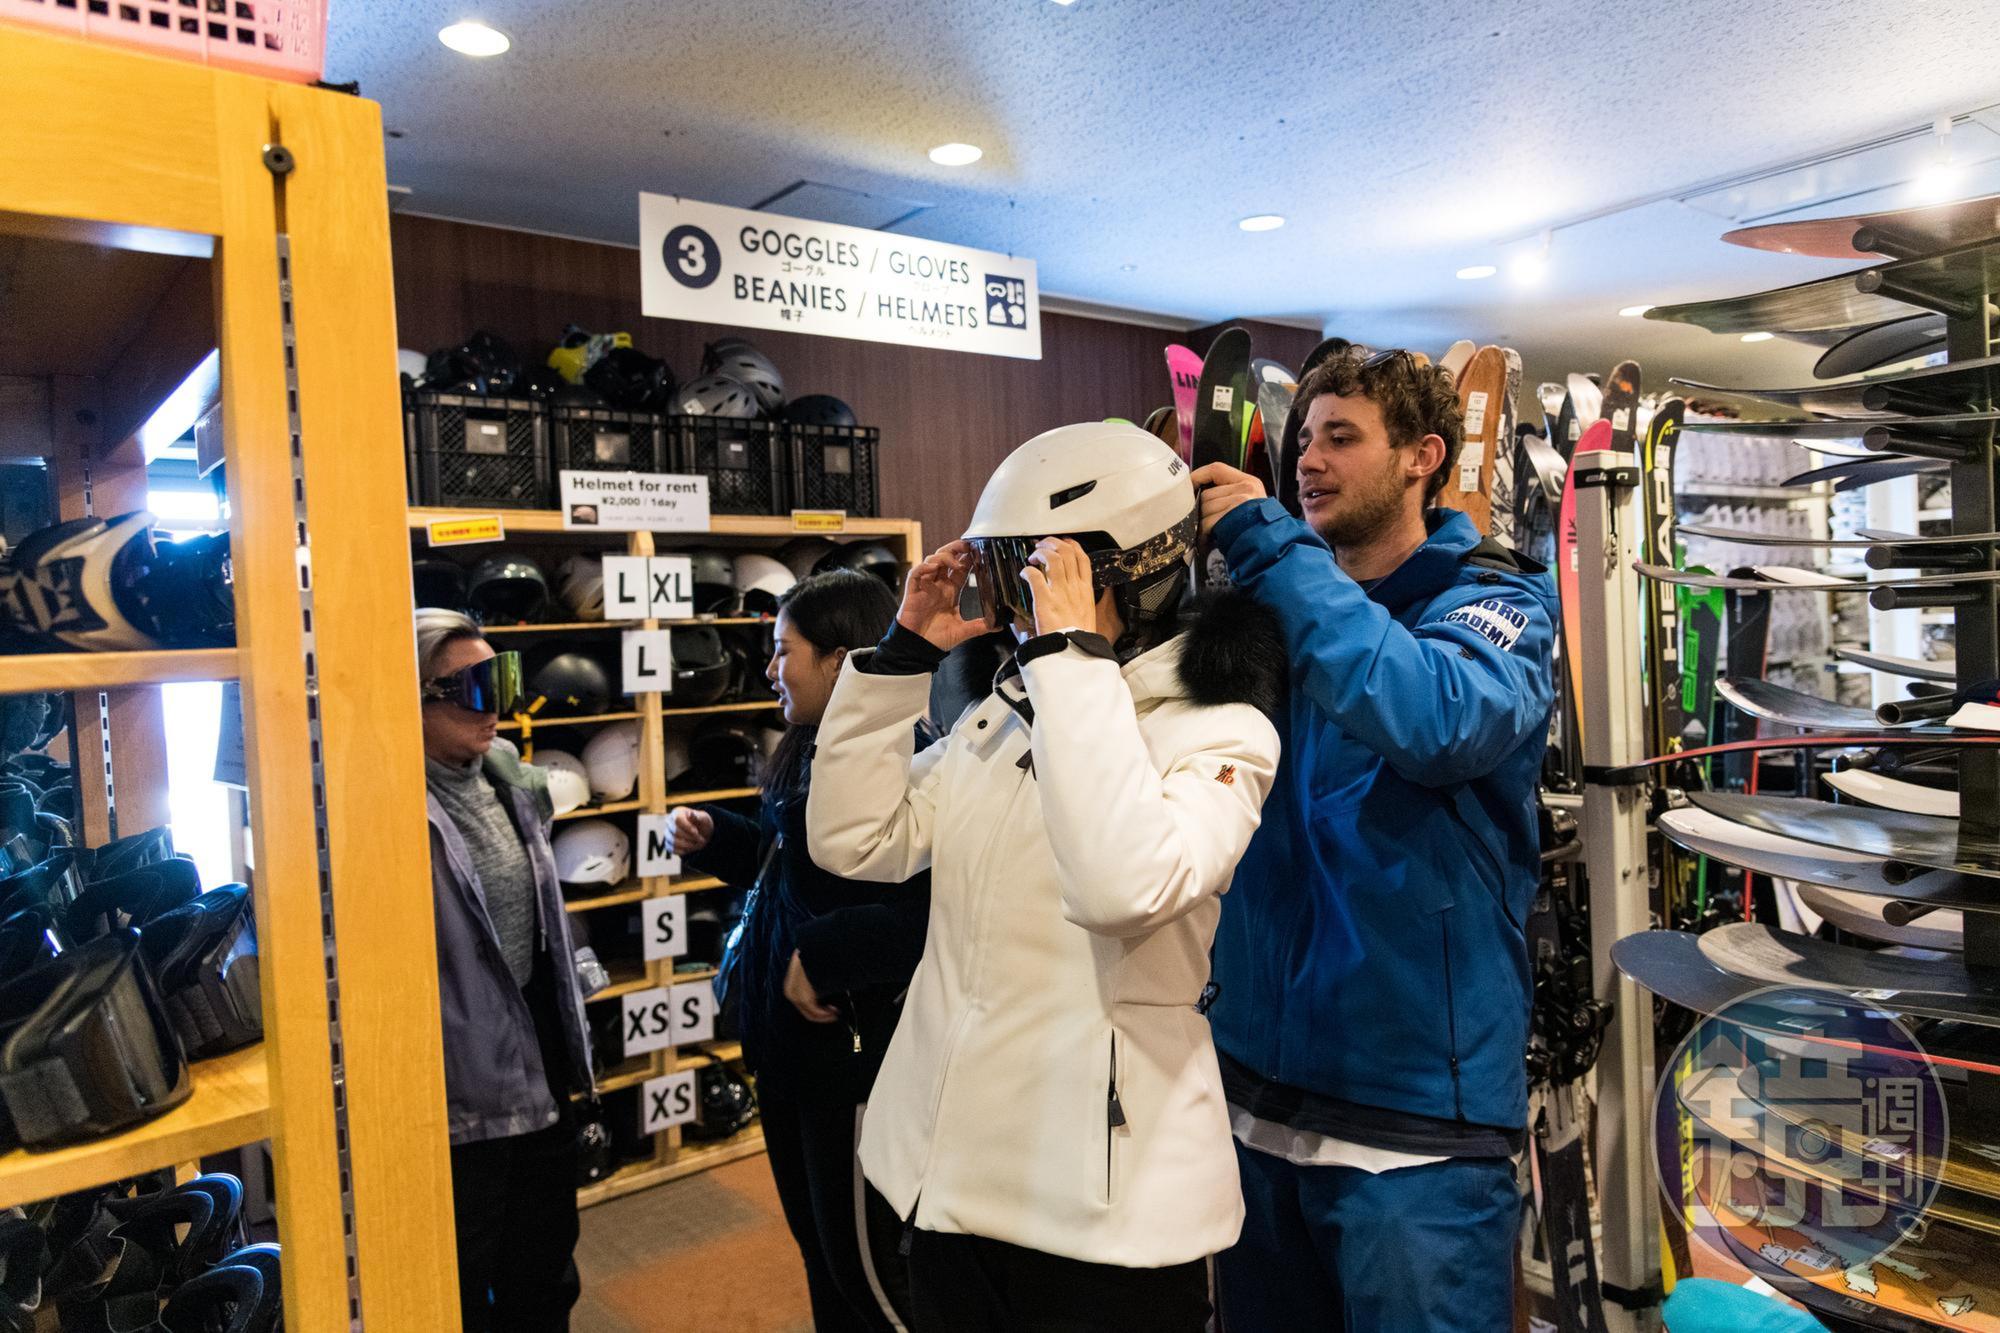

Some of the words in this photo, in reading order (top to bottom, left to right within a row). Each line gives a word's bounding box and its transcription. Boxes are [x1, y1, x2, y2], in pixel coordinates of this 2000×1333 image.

[677, 235, 707, 276] 3
[739, 226, 859, 267] GOGGLES
[889, 251, 970, 284] GLOVES
[781, 261, 826, 277] ゴーグル
[734, 274, 847, 312] BEANIES
[878, 294, 978, 329] HELMETS
[573, 477, 634, 491] Helmet
[639, 479, 661, 492] for
[666, 482, 698, 493] rent
[602, 497, 641, 507] ¥2,000
[1654, 467, 1678, 661] HEAD
[619, 572, 636, 604] L
[652, 572, 693, 603] XL
[1474, 600, 1526, 629] ORO
[638, 645, 657, 677] L
[647, 830, 672, 861] M
[656, 911, 674, 944] S
[627, 1002, 669, 1042] XS
[682, 997, 700, 1029] S
[651, 1083, 691, 1123] XS
